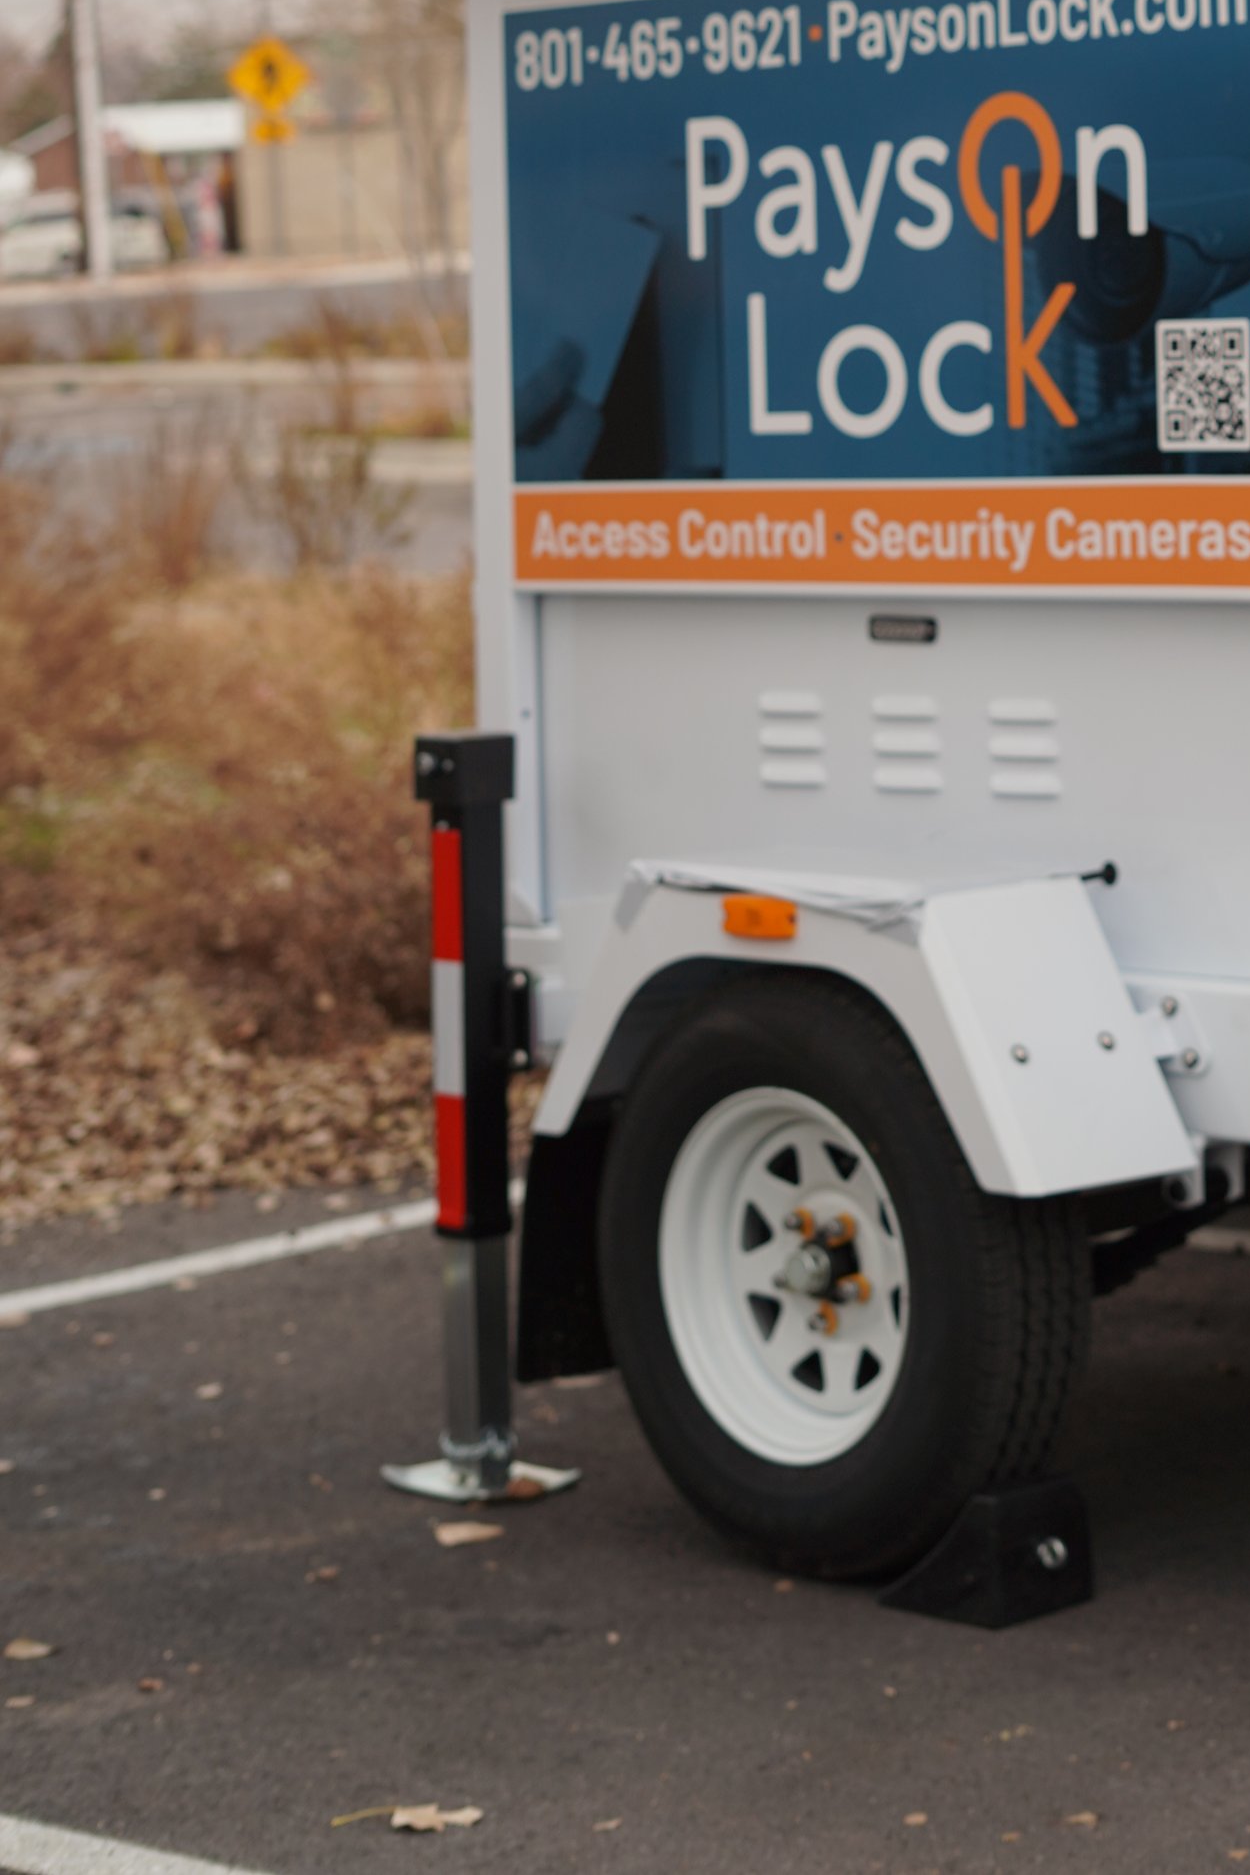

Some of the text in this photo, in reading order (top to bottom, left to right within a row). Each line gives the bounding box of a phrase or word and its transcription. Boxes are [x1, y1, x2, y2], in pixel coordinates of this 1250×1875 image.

[531, 510, 671, 559] Access
[677, 508, 827, 559] Control
[851, 507, 1035, 572] Security
